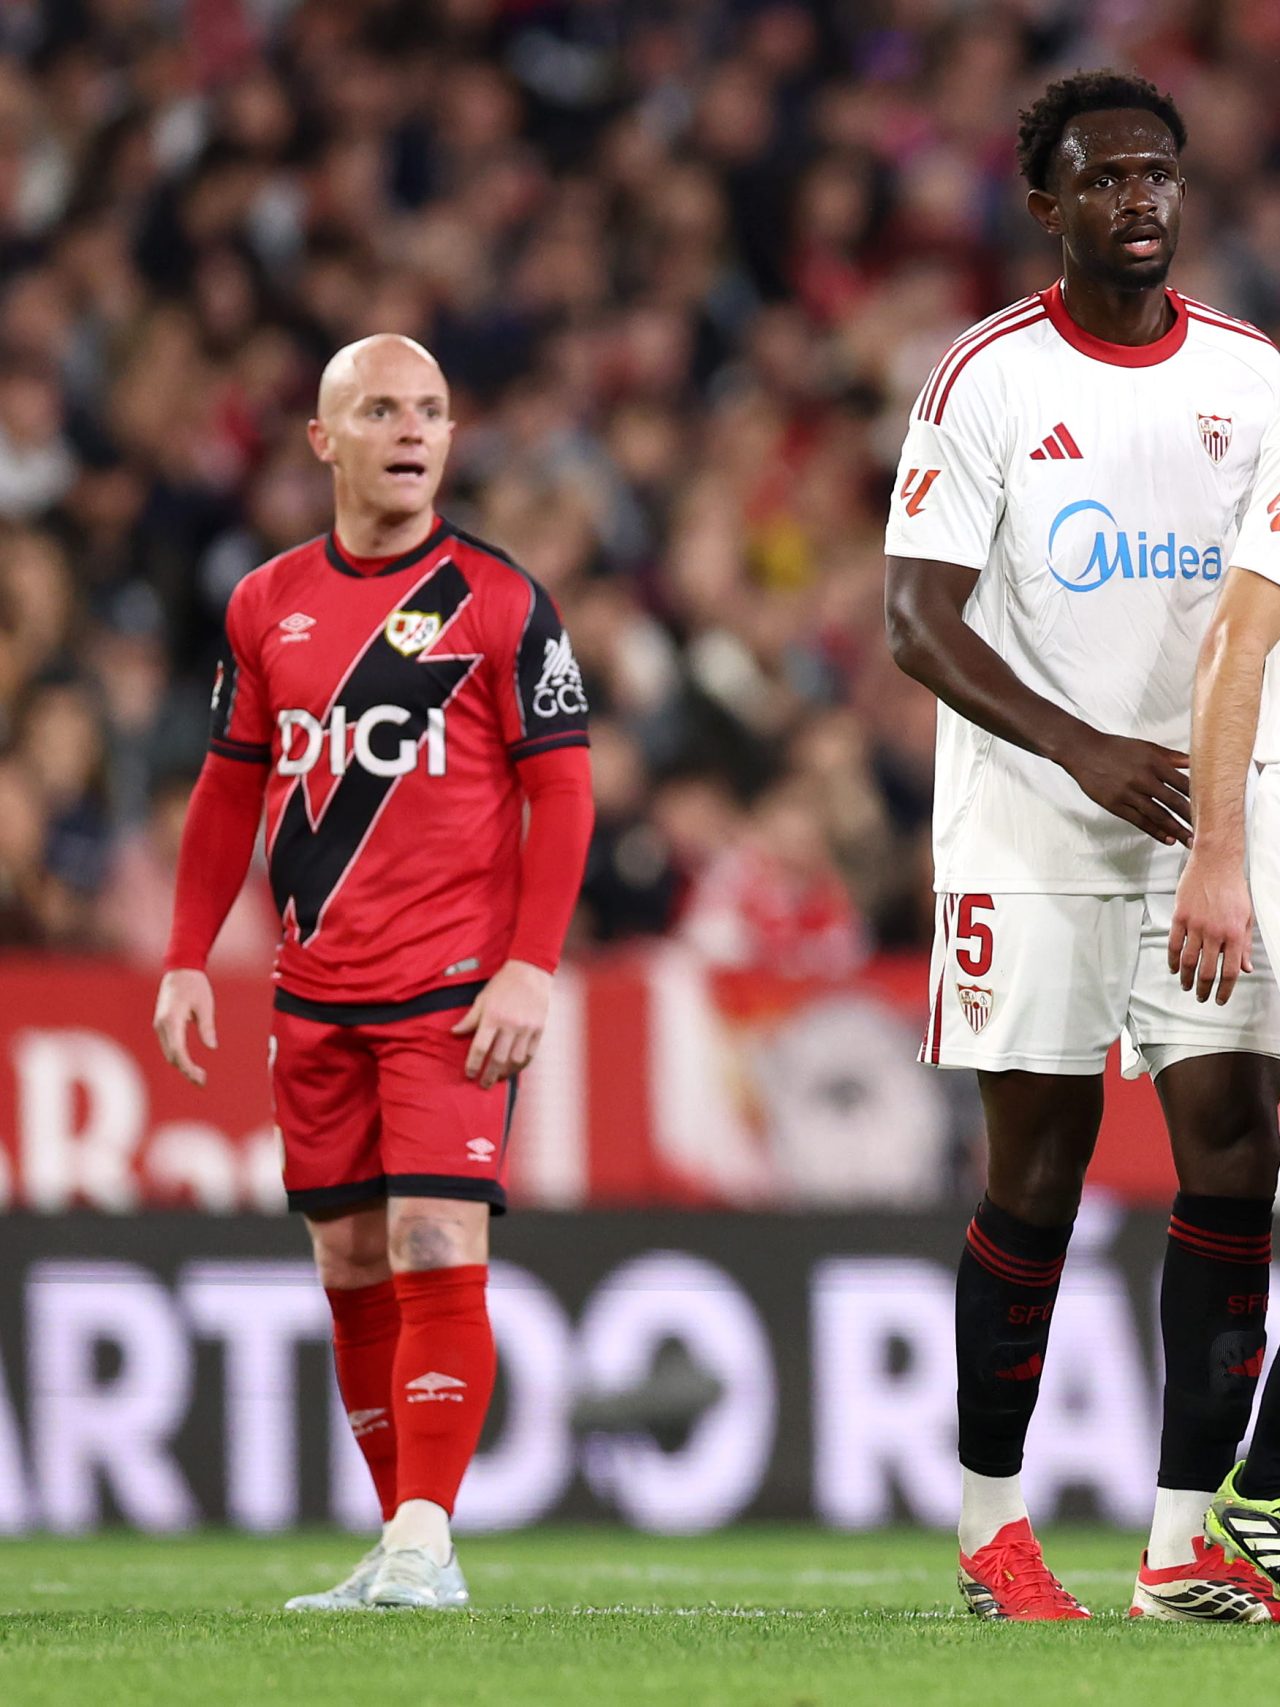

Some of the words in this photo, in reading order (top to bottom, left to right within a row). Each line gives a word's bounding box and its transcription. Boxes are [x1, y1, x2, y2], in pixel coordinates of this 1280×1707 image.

[1072, 529, 1222, 592] Midea
[277, 703, 447, 778] DIGI
[956, 893, 996, 978] 5
